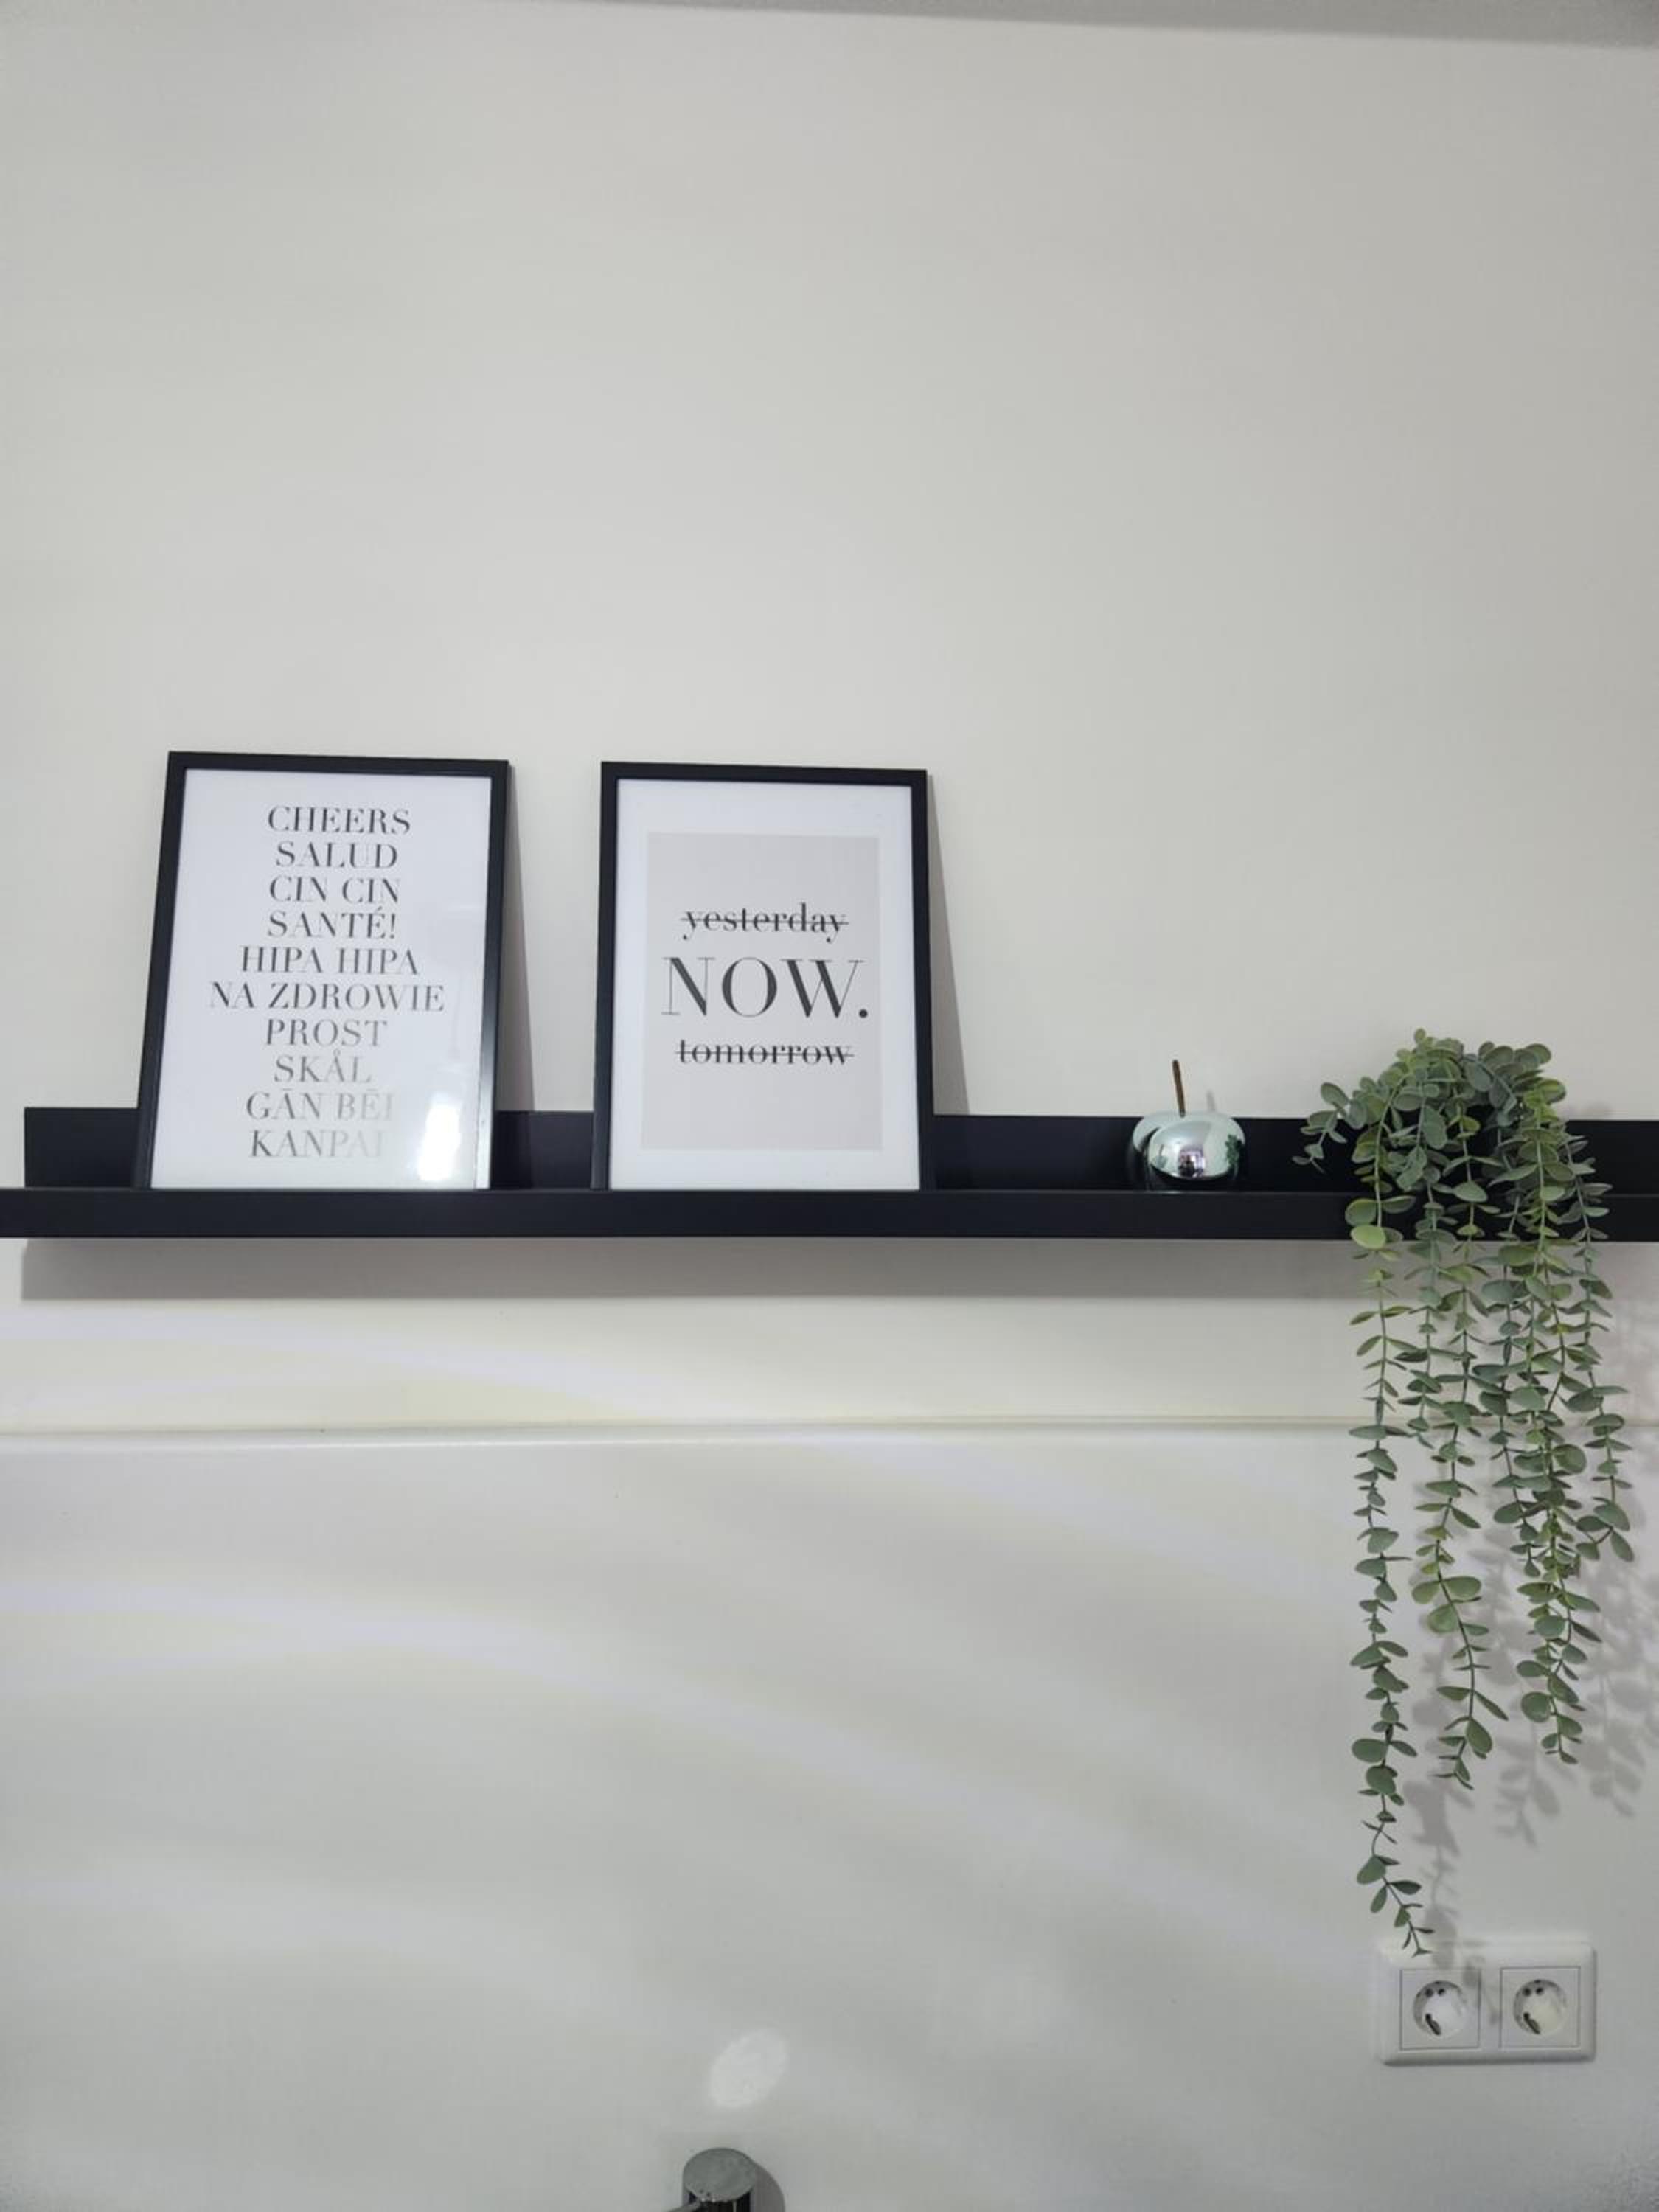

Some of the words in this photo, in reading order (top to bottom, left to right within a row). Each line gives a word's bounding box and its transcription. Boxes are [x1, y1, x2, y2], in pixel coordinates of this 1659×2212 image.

[268, 806, 411, 835] CHEERS
[276, 841, 397, 869] SALUD
[269, 875, 327, 904] CIN
[341, 877, 400, 904] CIN
[267, 906, 397, 939] SANTÉ!
[680, 902, 849, 943] yesterday
[241, 945, 323, 973] HIPA
[337, 948, 419, 975] HIPA
[209, 981, 255, 1009] NA
[268, 982, 445, 1012] ZDROWIE
[661, 956, 869, 1018] NOW.
[265, 1018, 388, 1047] PROST
[274, 1048, 372, 1083] SKÅL
[675, 1039, 855, 1066] tomorrow
